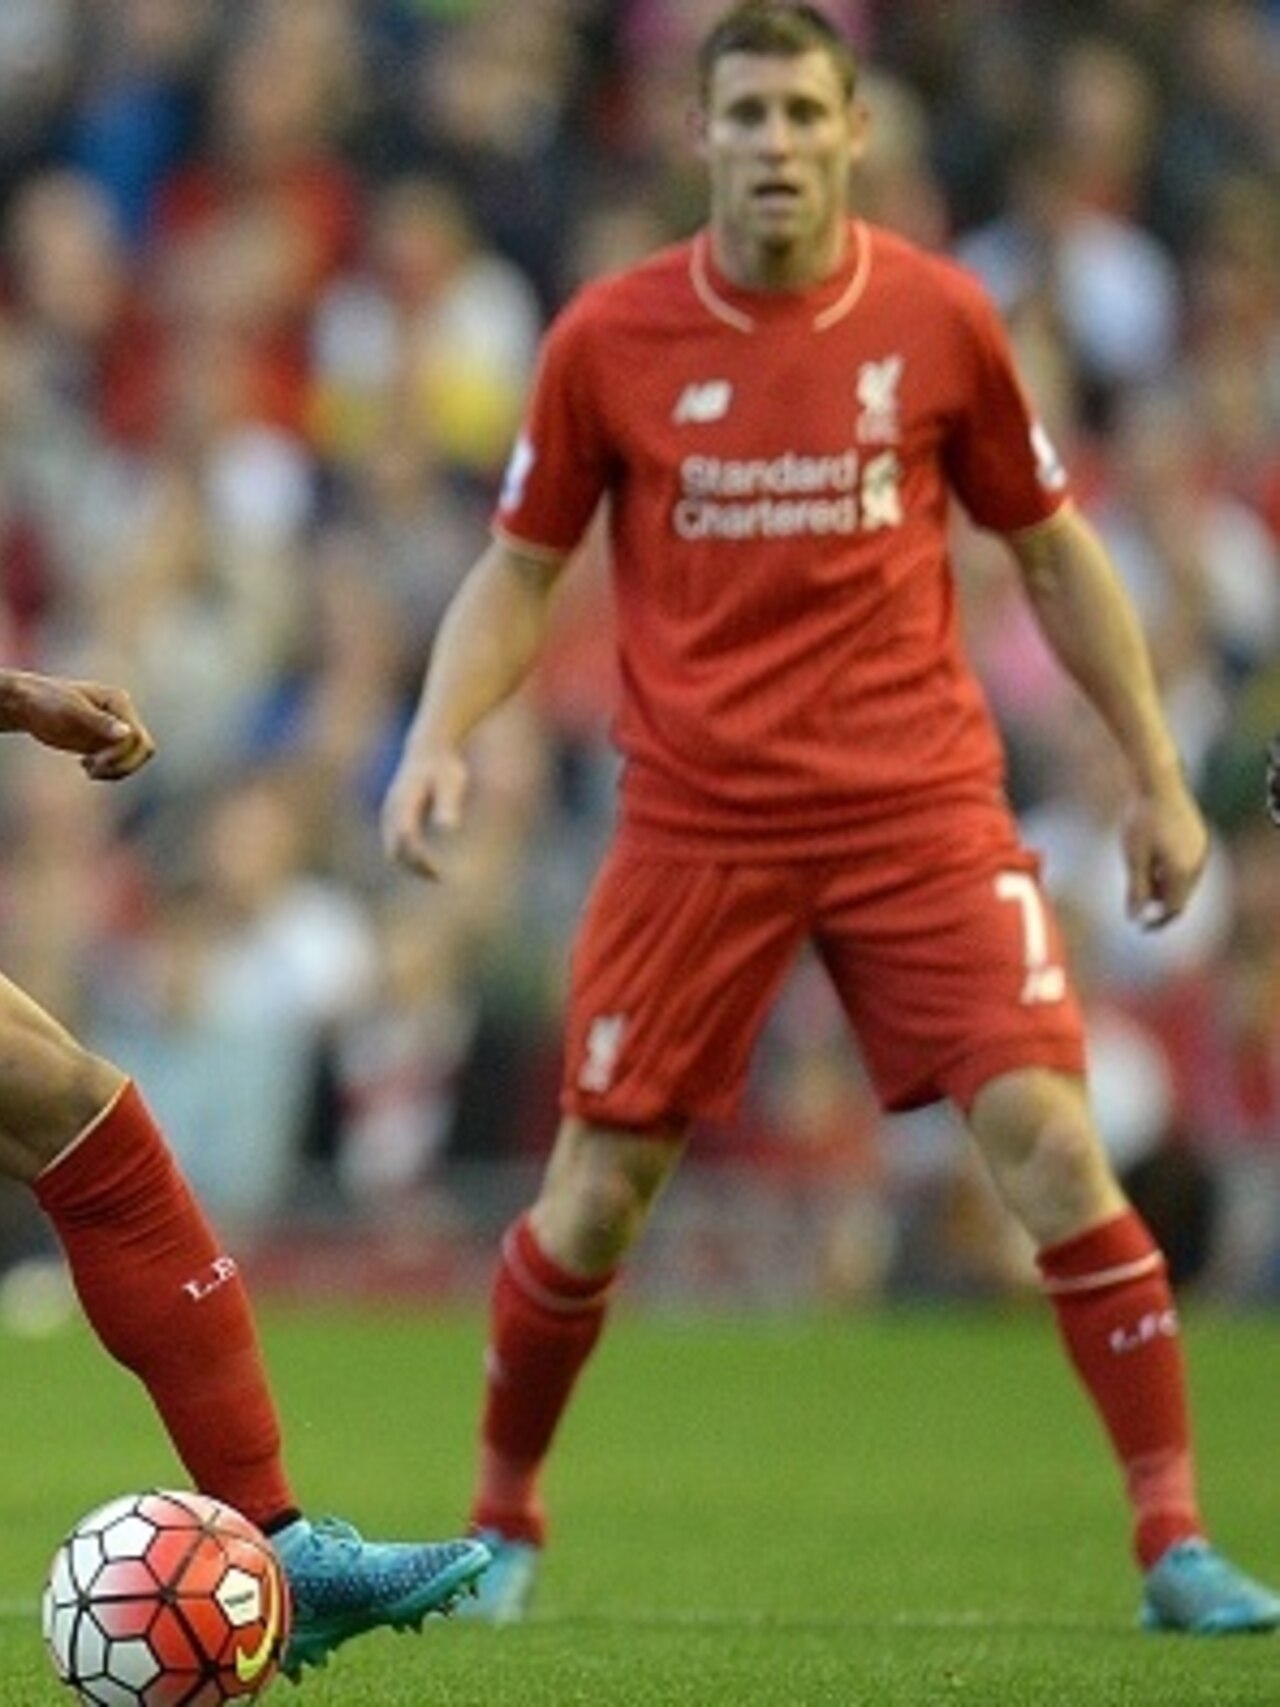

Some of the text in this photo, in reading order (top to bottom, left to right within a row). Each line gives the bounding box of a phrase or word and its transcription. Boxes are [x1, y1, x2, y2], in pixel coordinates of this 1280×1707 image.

[680, 449, 858, 496] Standard
[674, 496, 858, 540] Chartered
[994, 871, 1047, 968] 7
